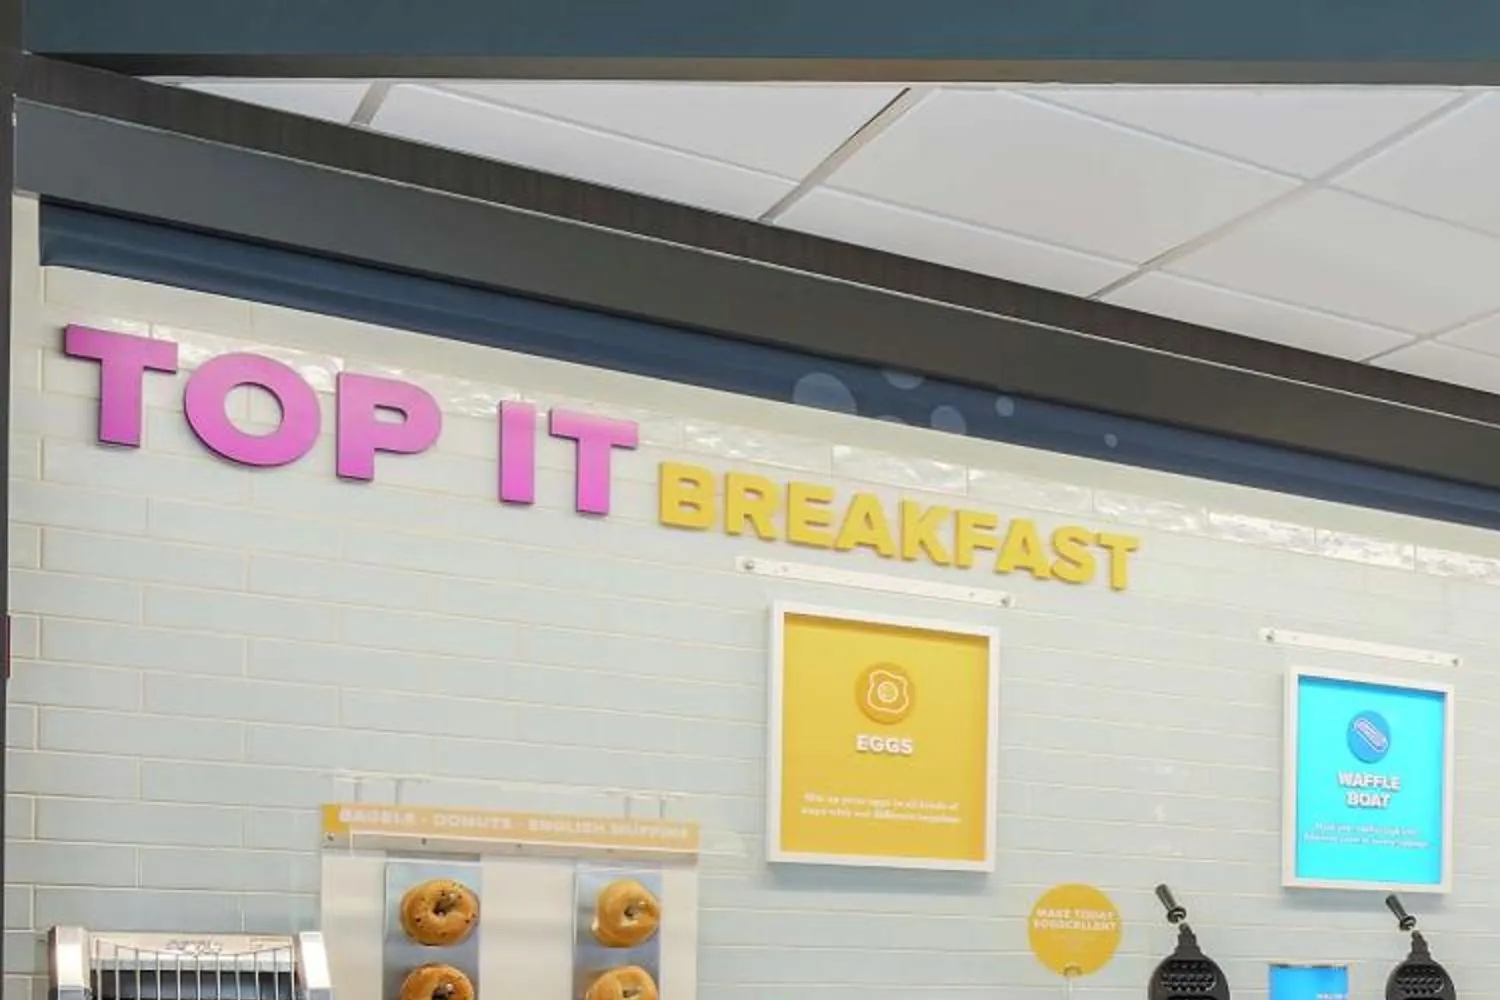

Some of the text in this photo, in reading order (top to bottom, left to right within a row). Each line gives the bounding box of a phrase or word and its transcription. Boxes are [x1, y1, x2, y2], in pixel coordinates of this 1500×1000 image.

[63, 323, 1139, 591] TOP IT BREAKFAST
[856, 734, 914, 755] EGGS
[1338, 771, 1401, 791] WAFFLE
[1346, 791, 1390, 808] BOAT
